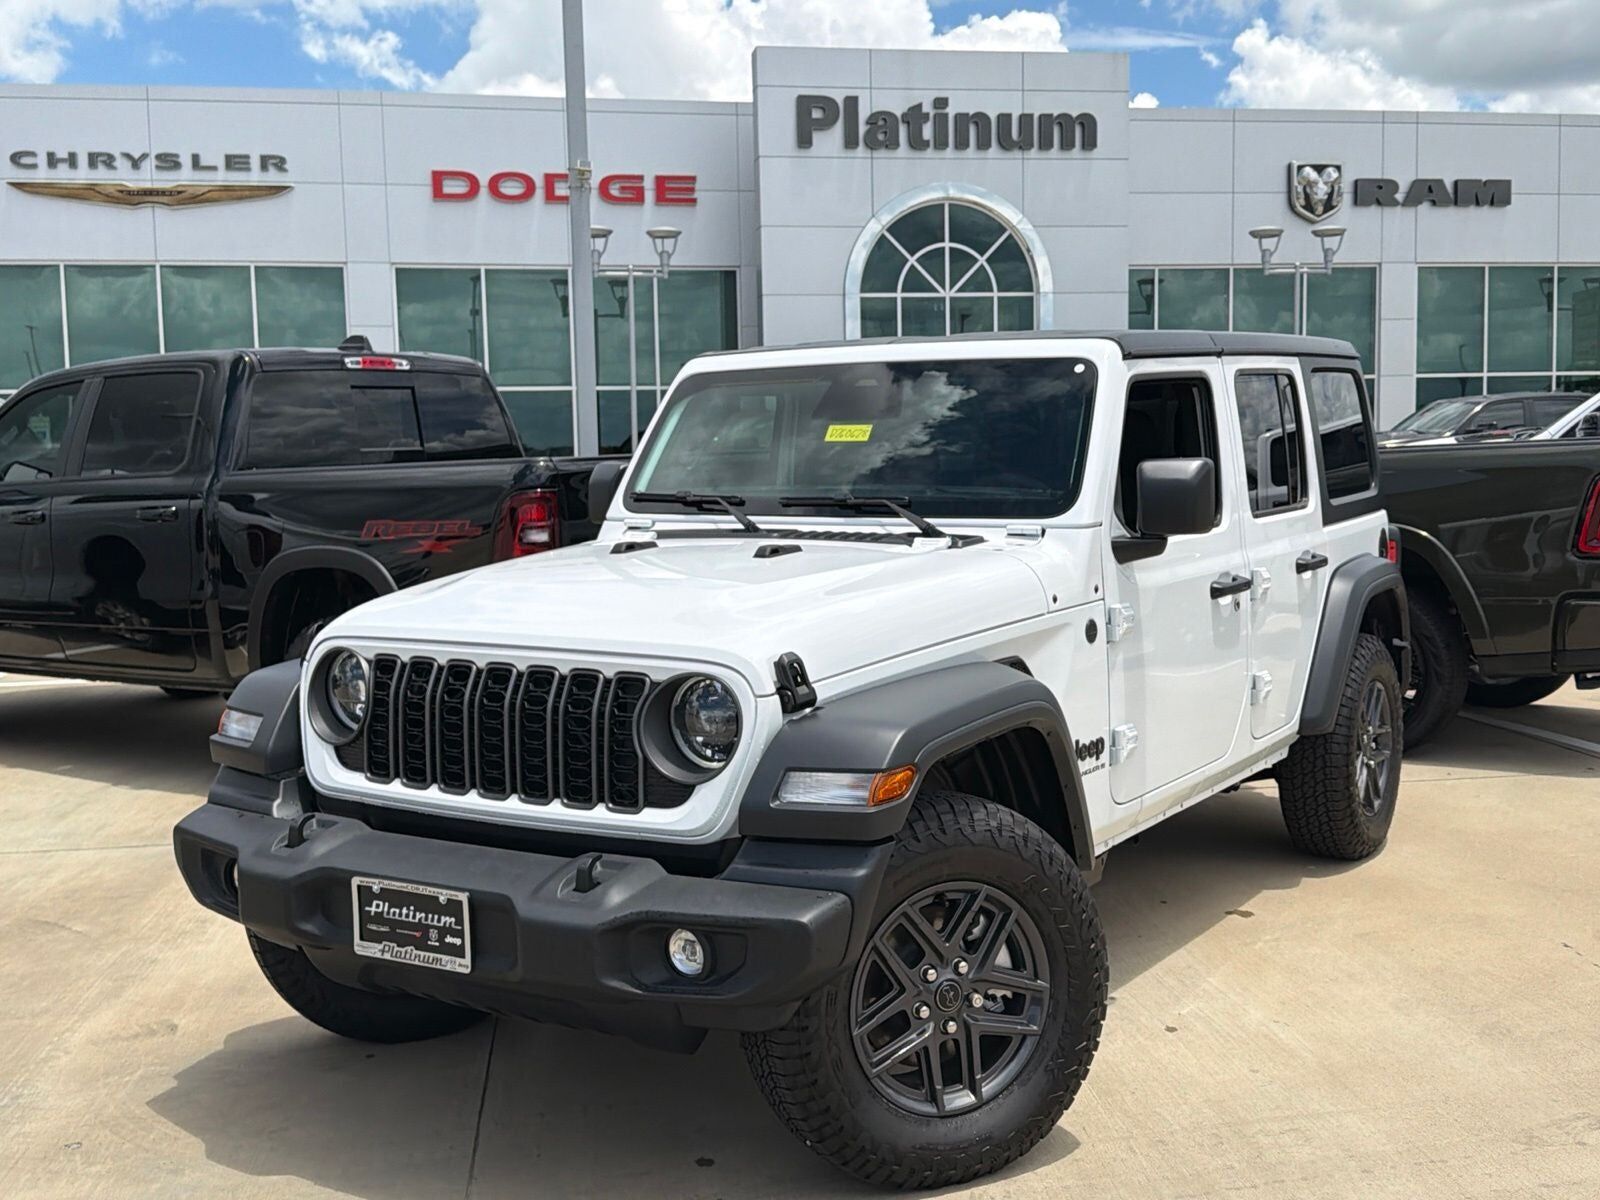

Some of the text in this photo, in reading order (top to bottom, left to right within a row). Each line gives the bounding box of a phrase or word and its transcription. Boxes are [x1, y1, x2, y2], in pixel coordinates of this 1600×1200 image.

[796, 94, 1097, 150] Platinum
[9, 150, 288, 173] CHRYSLER
[1354, 178, 1512, 207] RAM
[361, 520, 482, 540] REBEL
[365, 900, 462, 929] Platinum
[445, 934, 462, 946] Jeep
[378, 943, 448, 967] Platinum
